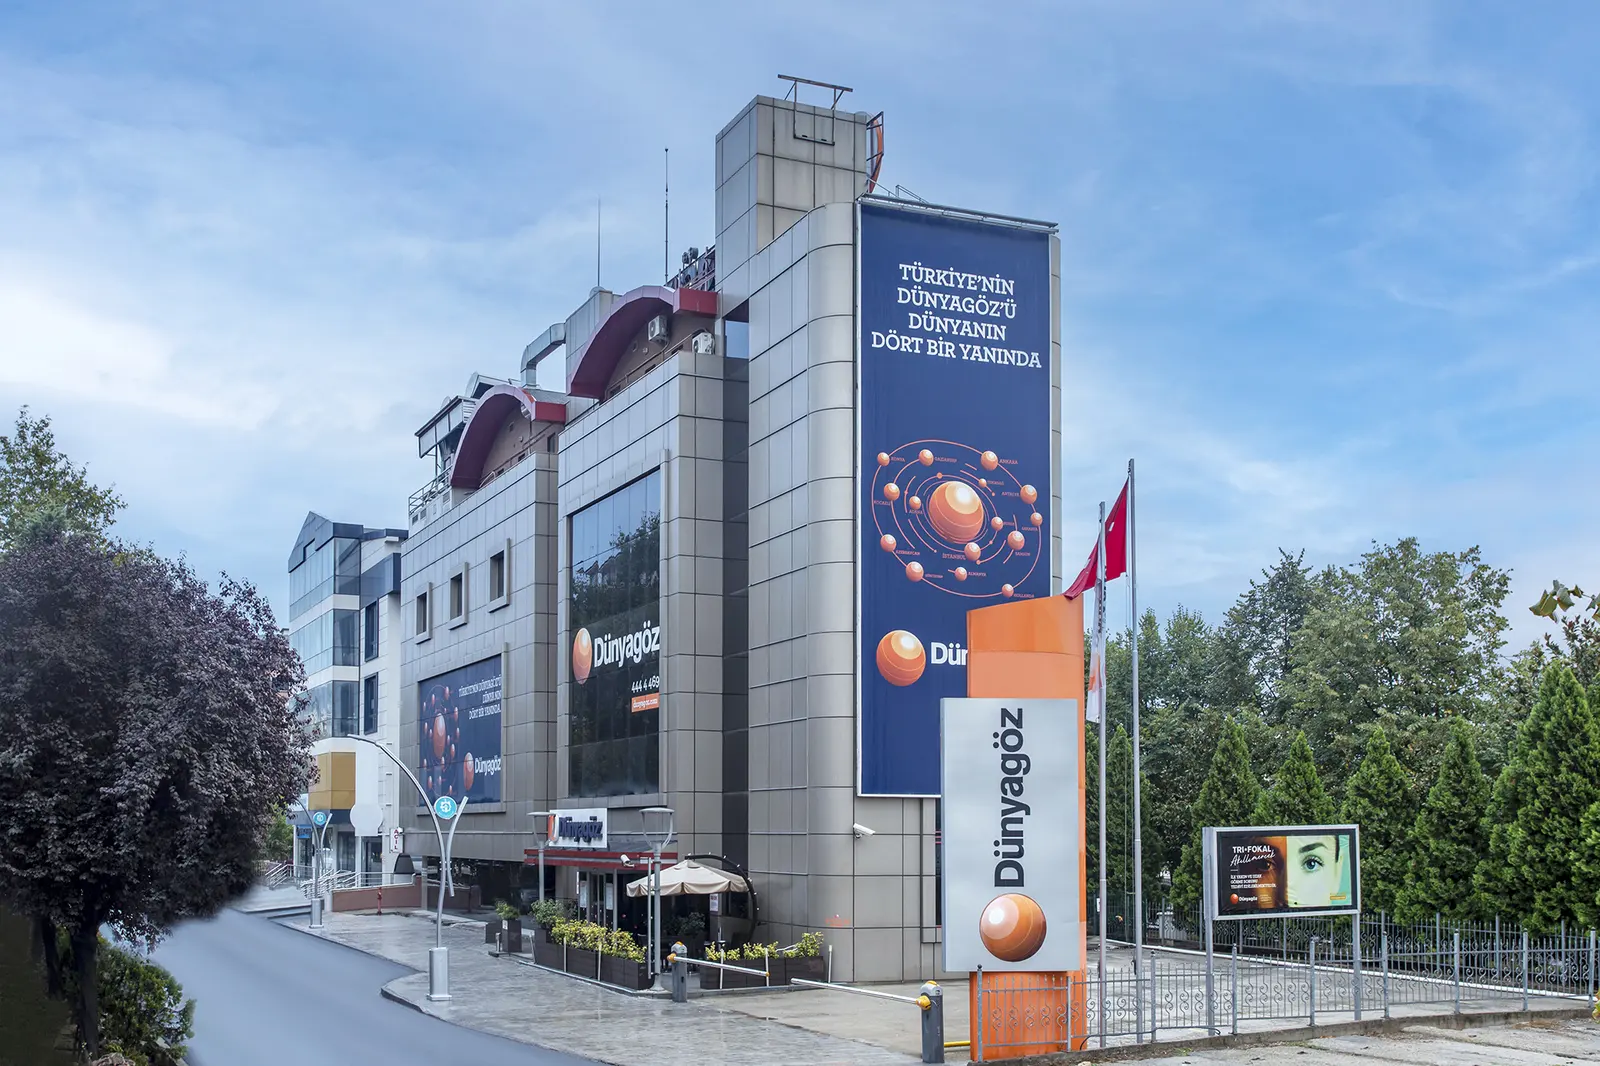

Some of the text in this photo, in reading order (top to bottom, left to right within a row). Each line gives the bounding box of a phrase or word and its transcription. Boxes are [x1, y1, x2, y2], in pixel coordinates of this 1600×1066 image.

[899, 261, 1015, 295] TÜRKİYE'NİN
[908, 311, 1006, 341] DÜNYANIN
[871, 329, 1042, 368] DÖRT BİR YANINDA
[594, 620, 660, 668] Dünyagöz
[475, 755, 501, 775] Dünyagöz
[991, 707, 1031, 888] Dünyagöz
[559, 816, 603, 844] Dünyagöz
